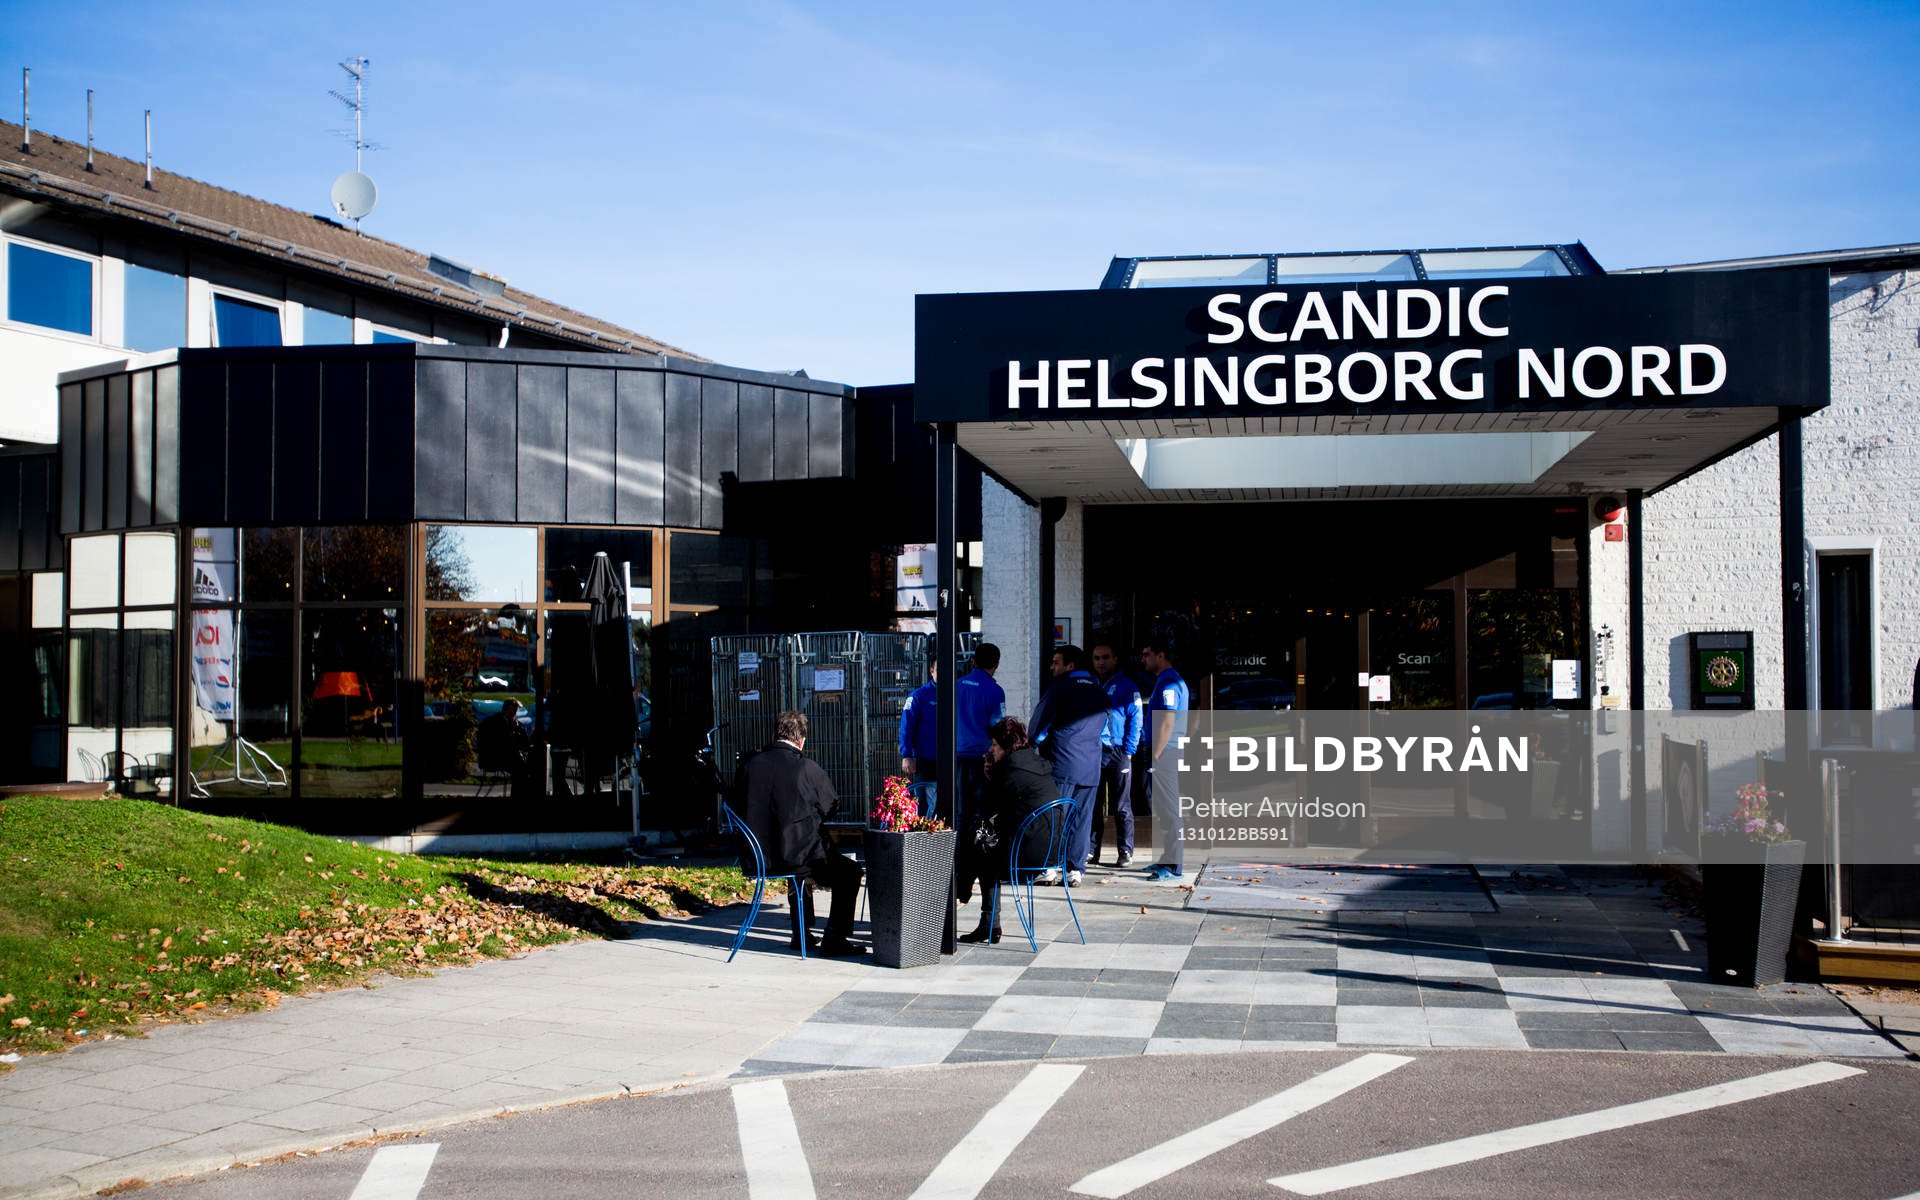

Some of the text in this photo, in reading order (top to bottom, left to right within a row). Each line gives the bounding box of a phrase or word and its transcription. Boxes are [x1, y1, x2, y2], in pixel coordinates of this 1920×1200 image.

[1206, 285, 1510, 344] SCANDIC
[1007, 343, 1727, 409] HELSINGBORG NORD
[1215, 653, 1268, 666] Scandic
